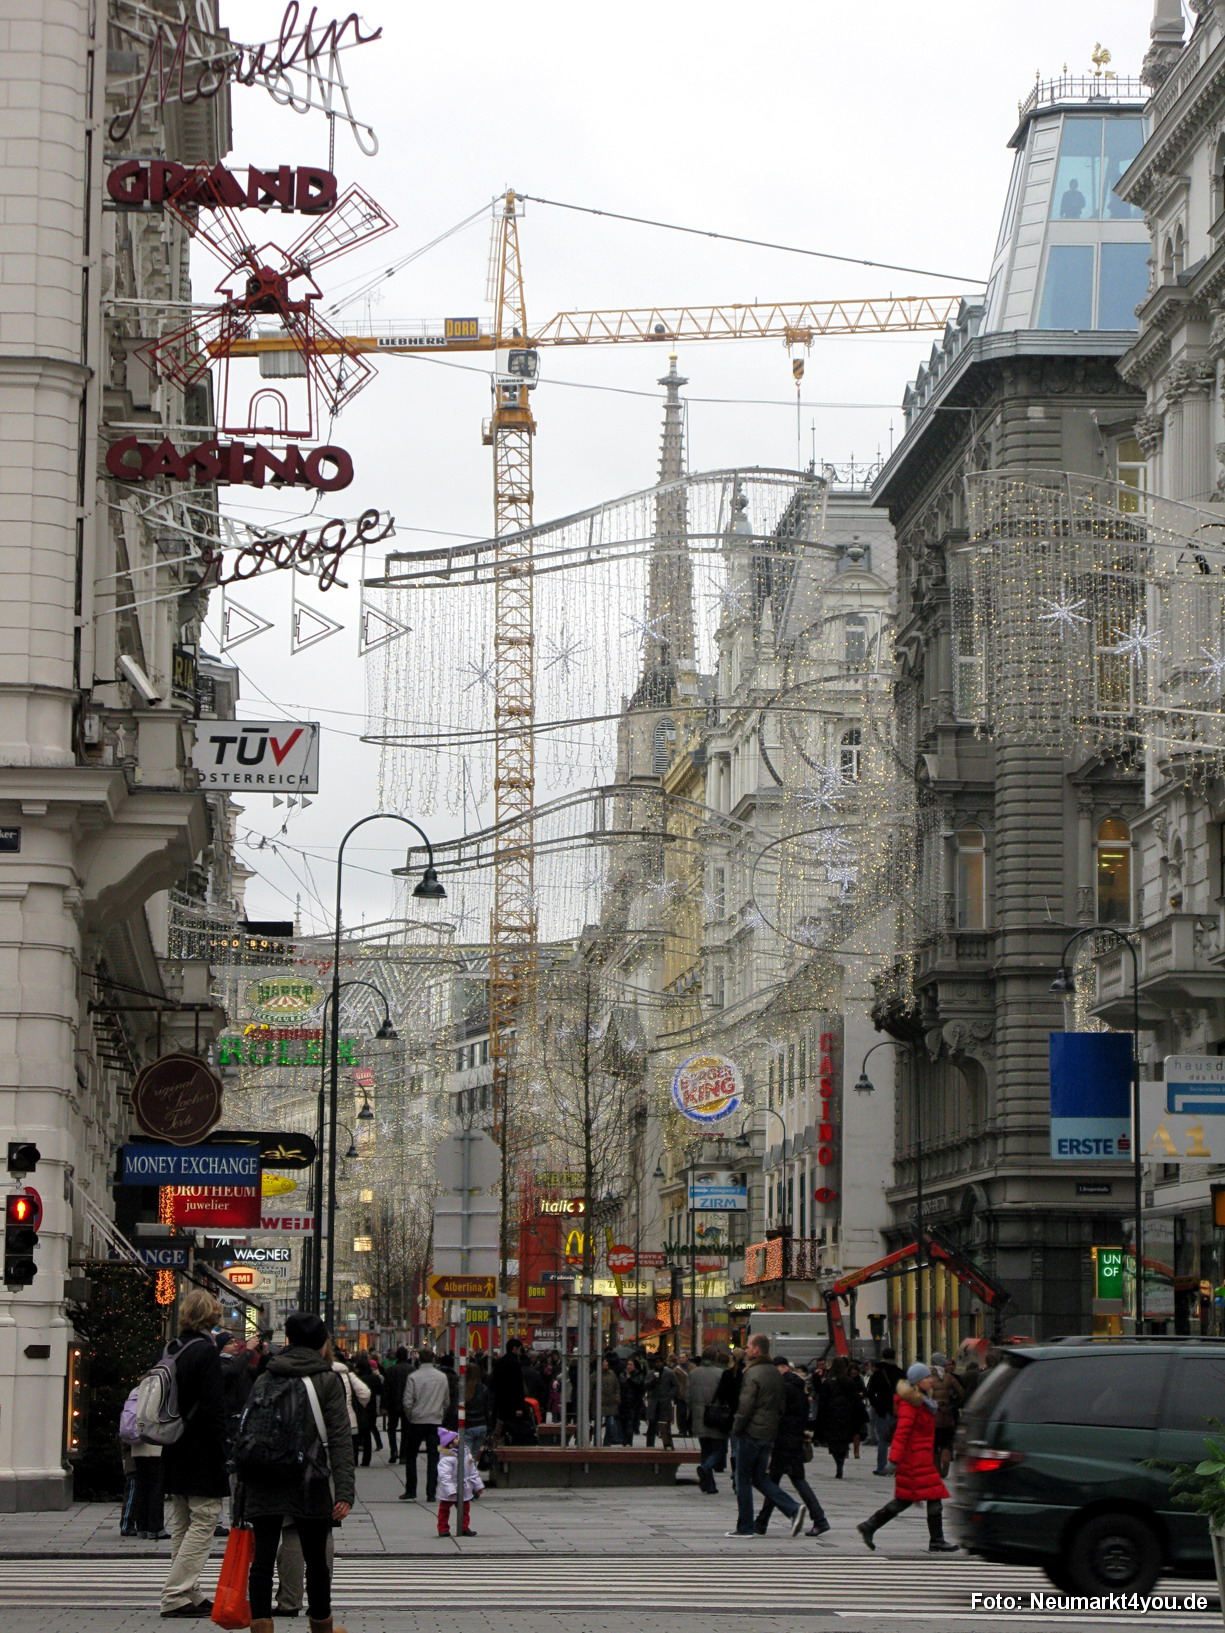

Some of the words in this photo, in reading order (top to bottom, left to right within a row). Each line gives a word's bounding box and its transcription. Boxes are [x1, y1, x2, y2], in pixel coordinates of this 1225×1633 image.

[109, 1, 382, 142] Moulin
[107, 160, 338, 215] GRAND
[380, 338, 445, 346] LIEBHERR
[105, 436, 354, 491] CASINO
[209, 728, 304, 767] TÜV
[218, 1038, 358, 1065] ROLEX
[683, 1077, 735, 1108] KING
[818, 1033, 833, 1167] CASINO
[1058, 1138, 1114, 1155] ERSTE
[1140, 1125, 1211, 1157] A1
[126, 1157, 176, 1174] MONEY
[181, 1157, 257, 1175] EXCHANGE
[185, 1200, 229, 1213] juwelier
[700, 1198, 736, 1208] ZIRM
[234, 1249, 289, 1260] WAGNER
[1103, 1255, 1121, 1264] UN
[232, 1275, 251, 1283] EMI
[1103, 1267, 1119, 1277] OF
[444, 1282, 482, 1292] Albertina
